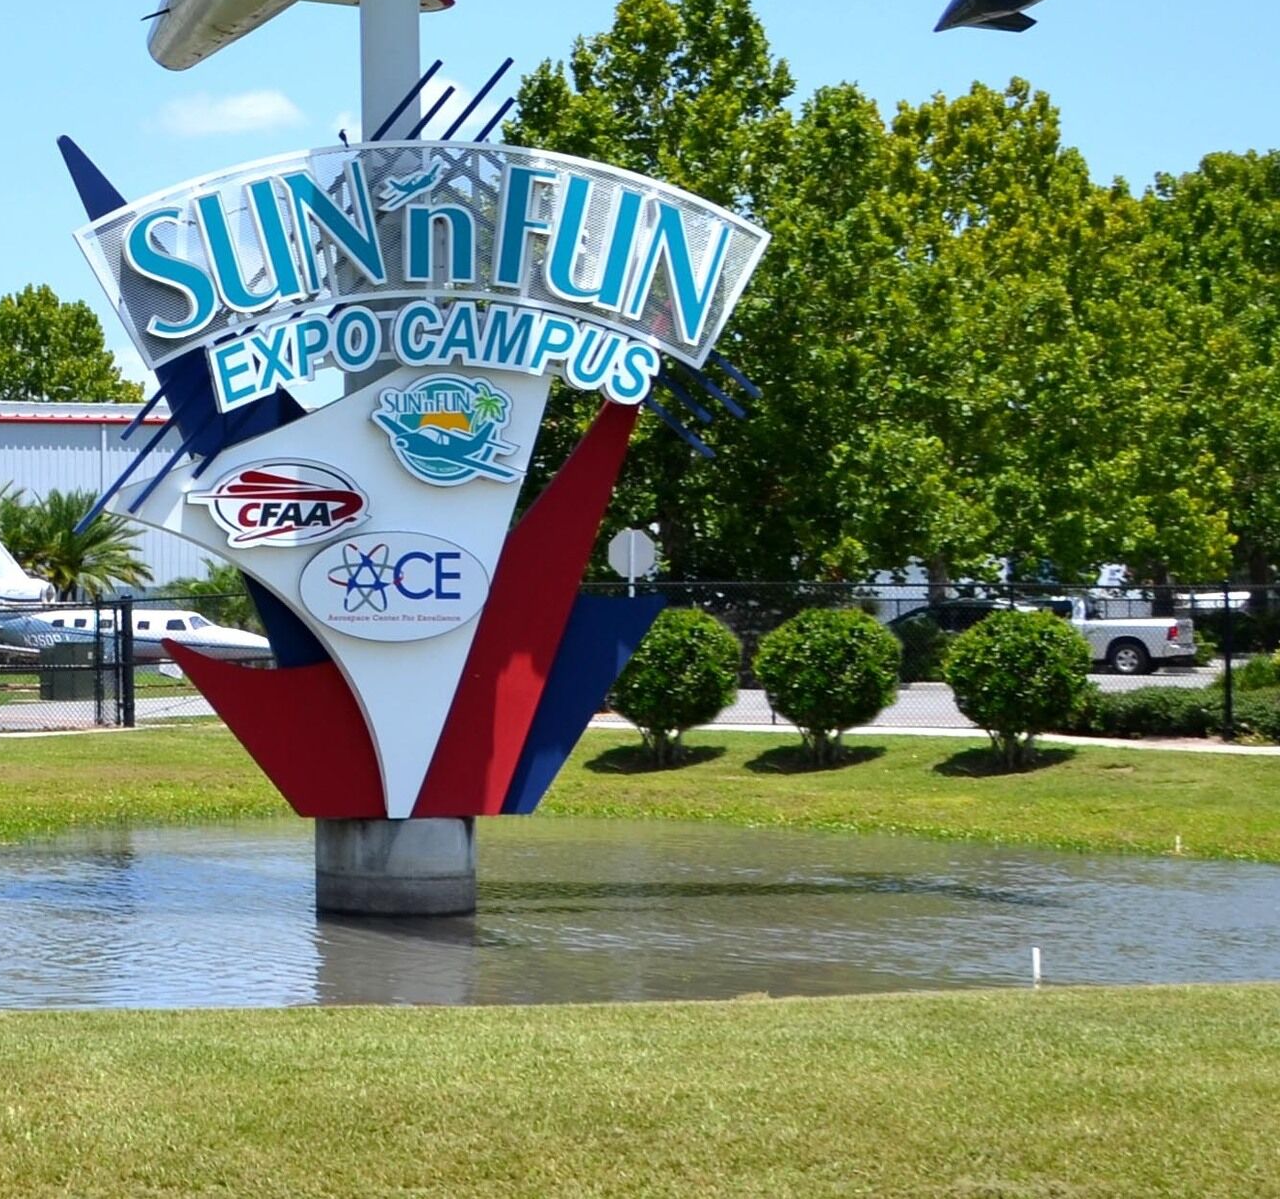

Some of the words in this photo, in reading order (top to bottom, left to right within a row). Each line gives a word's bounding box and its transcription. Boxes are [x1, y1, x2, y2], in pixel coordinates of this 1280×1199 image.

[124, 160, 386, 338] SUN
[495, 164, 733, 346] FUN
[212, 308, 378, 407] EXPO
[397, 304, 656, 401] CAMPUS
[237, 502, 331, 528] CFAA
